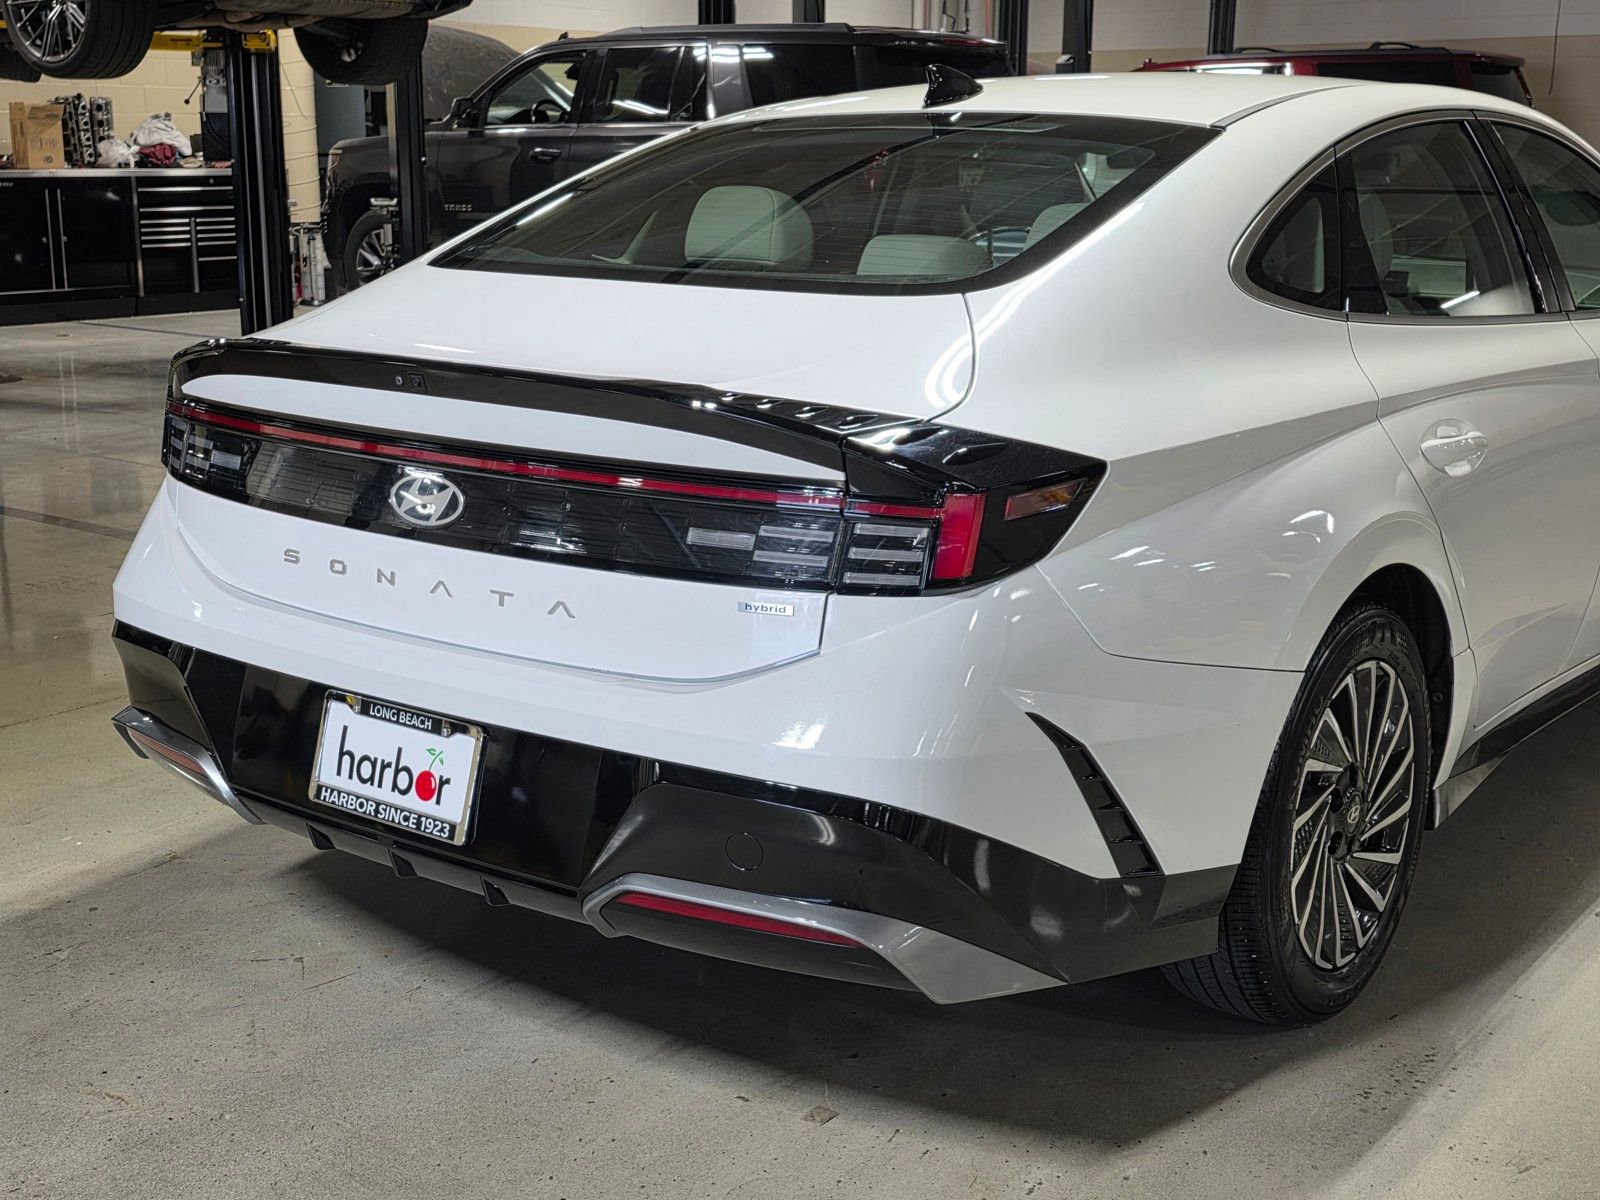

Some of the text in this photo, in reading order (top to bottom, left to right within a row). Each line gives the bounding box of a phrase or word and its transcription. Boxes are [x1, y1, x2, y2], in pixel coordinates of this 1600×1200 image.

[283, 548, 576, 619] SONATA
[744, 602, 786, 613] hybrid
[369, 703, 432, 731] LONG BEACH
[336, 724, 451, 806] harbor
[320, 786, 450, 838] HARBOR SINCE 1923
